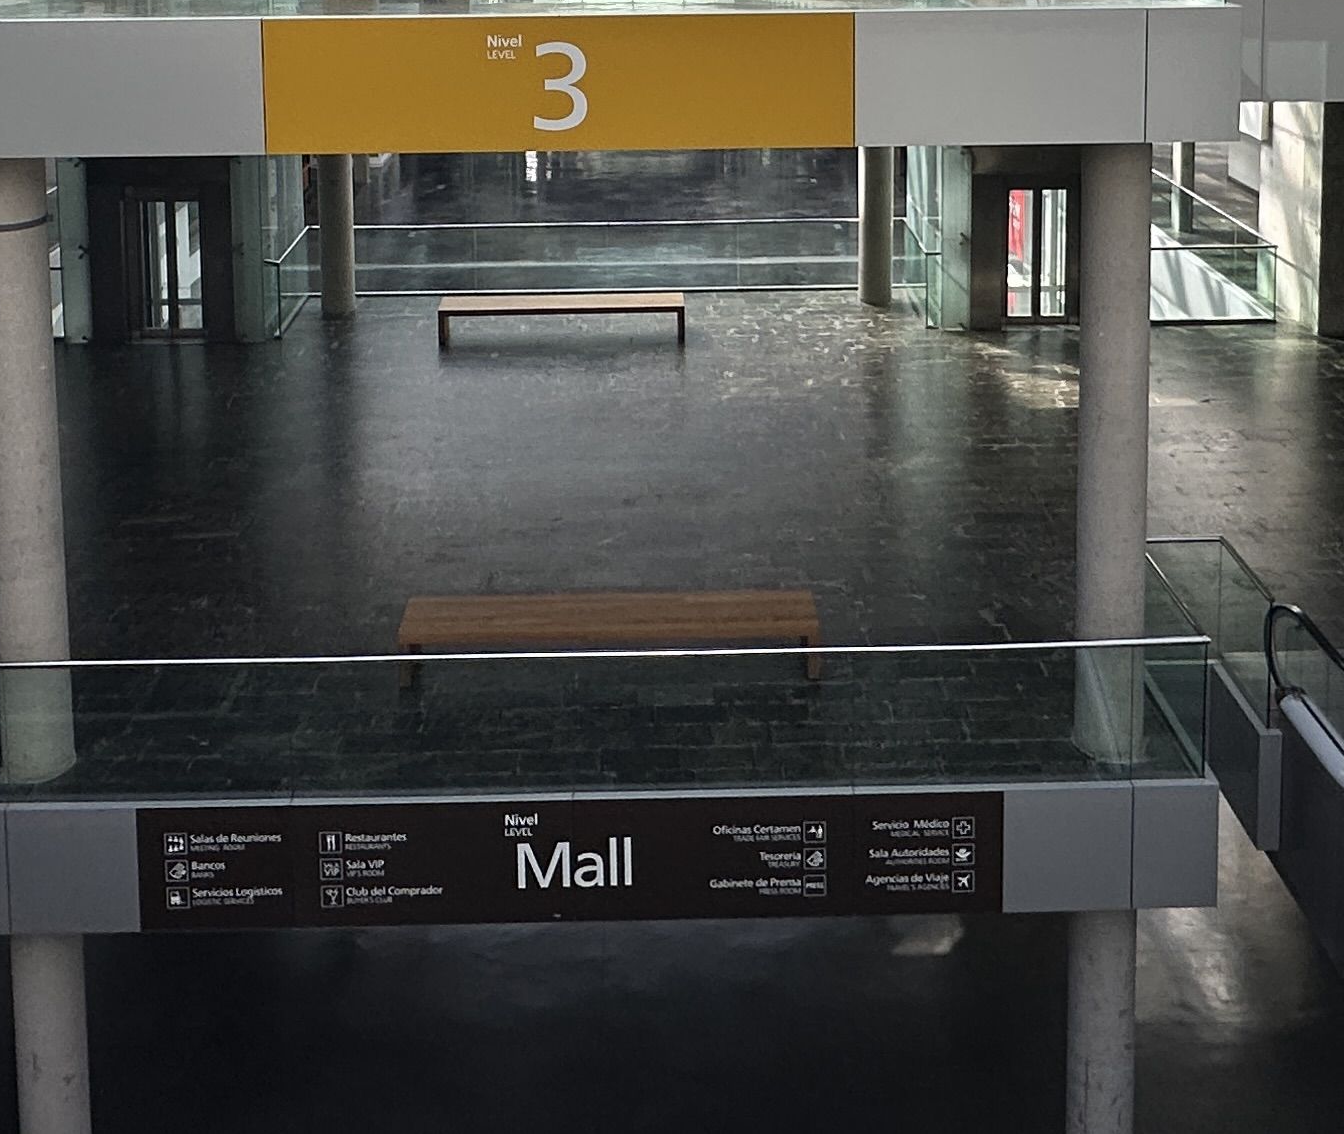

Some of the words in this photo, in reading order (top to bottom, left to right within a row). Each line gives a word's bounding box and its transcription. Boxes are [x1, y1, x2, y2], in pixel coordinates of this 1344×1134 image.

[487, 34, 522, 48] Nivel
[487, 50, 516, 60] LEVEL
[534, 41, 588, 131] 3
[504, 813, 538, 826] Nivel
[871, 820, 909, 830] Servicio
[504, 828, 533, 837] LEVEL
[712, 825, 752, 835] Oficinas
[753, 824, 801, 834] Certamen
[189, 833, 214, 843] Salas
[216, 833, 229, 843] de
[231, 833, 281, 843] Reuniones
[345, 833, 408, 842] Restaurantes
[868, 848, 889, 858] Sala
[891, 847, 949, 857] Autoridades
[191, 861, 226, 870] Bancos
[346, 860, 366, 869] Sala
[368, 859, 384, 868] VIP
[517, 837, 632, 889] Mall
[709, 879, 754, 888] Gabinete
[755, 878, 768, 887] de
[770, 877, 801, 887] Prensa
[865, 875, 909, 886] Agencias
[910, 874, 924, 883] de
[925, 873, 949, 884] Viaje
[192, 887, 233, 898] Servicios
[346, 886, 368, 896] Club
[370, 886, 385, 896] del
[388, 885, 443, 897] Comprador
